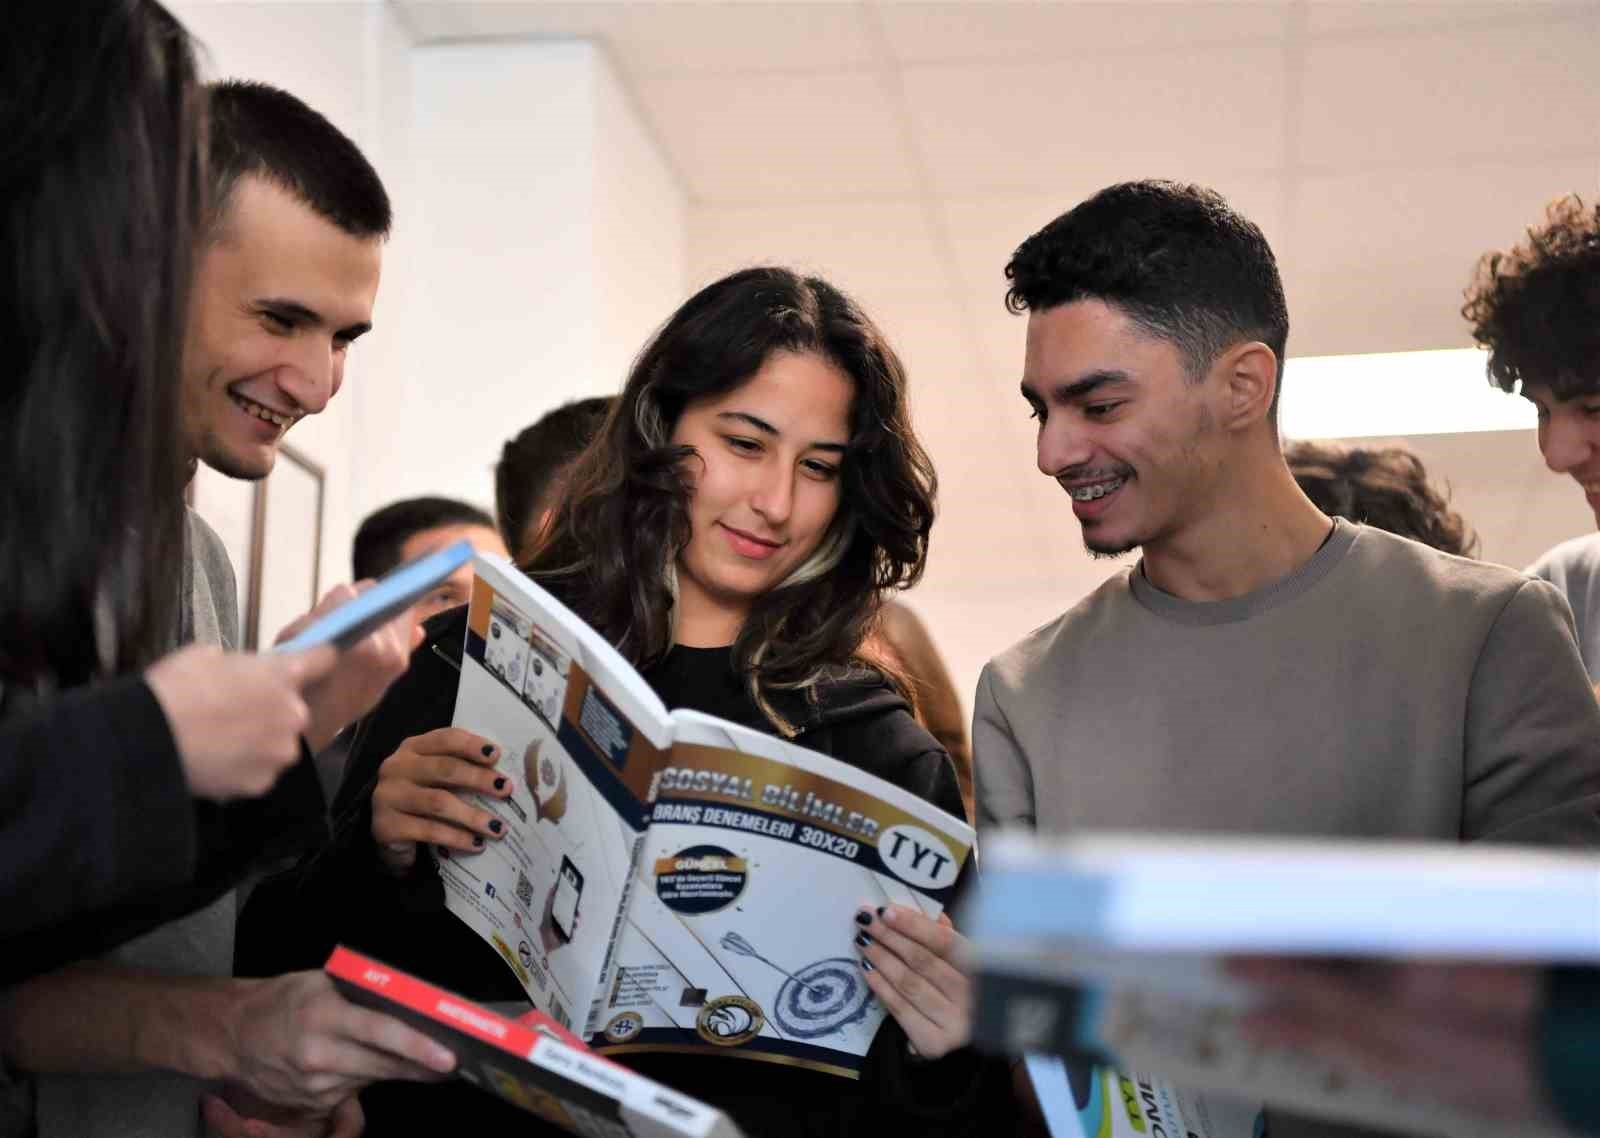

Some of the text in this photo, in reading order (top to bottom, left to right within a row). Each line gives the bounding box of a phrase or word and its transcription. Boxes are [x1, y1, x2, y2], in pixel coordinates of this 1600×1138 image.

[659, 767, 753, 800] SOSYAL
[652, 803, 859, 859] BRANŞ DENEMELERİ 30X20
[889, 831, 950, 880] TYT
